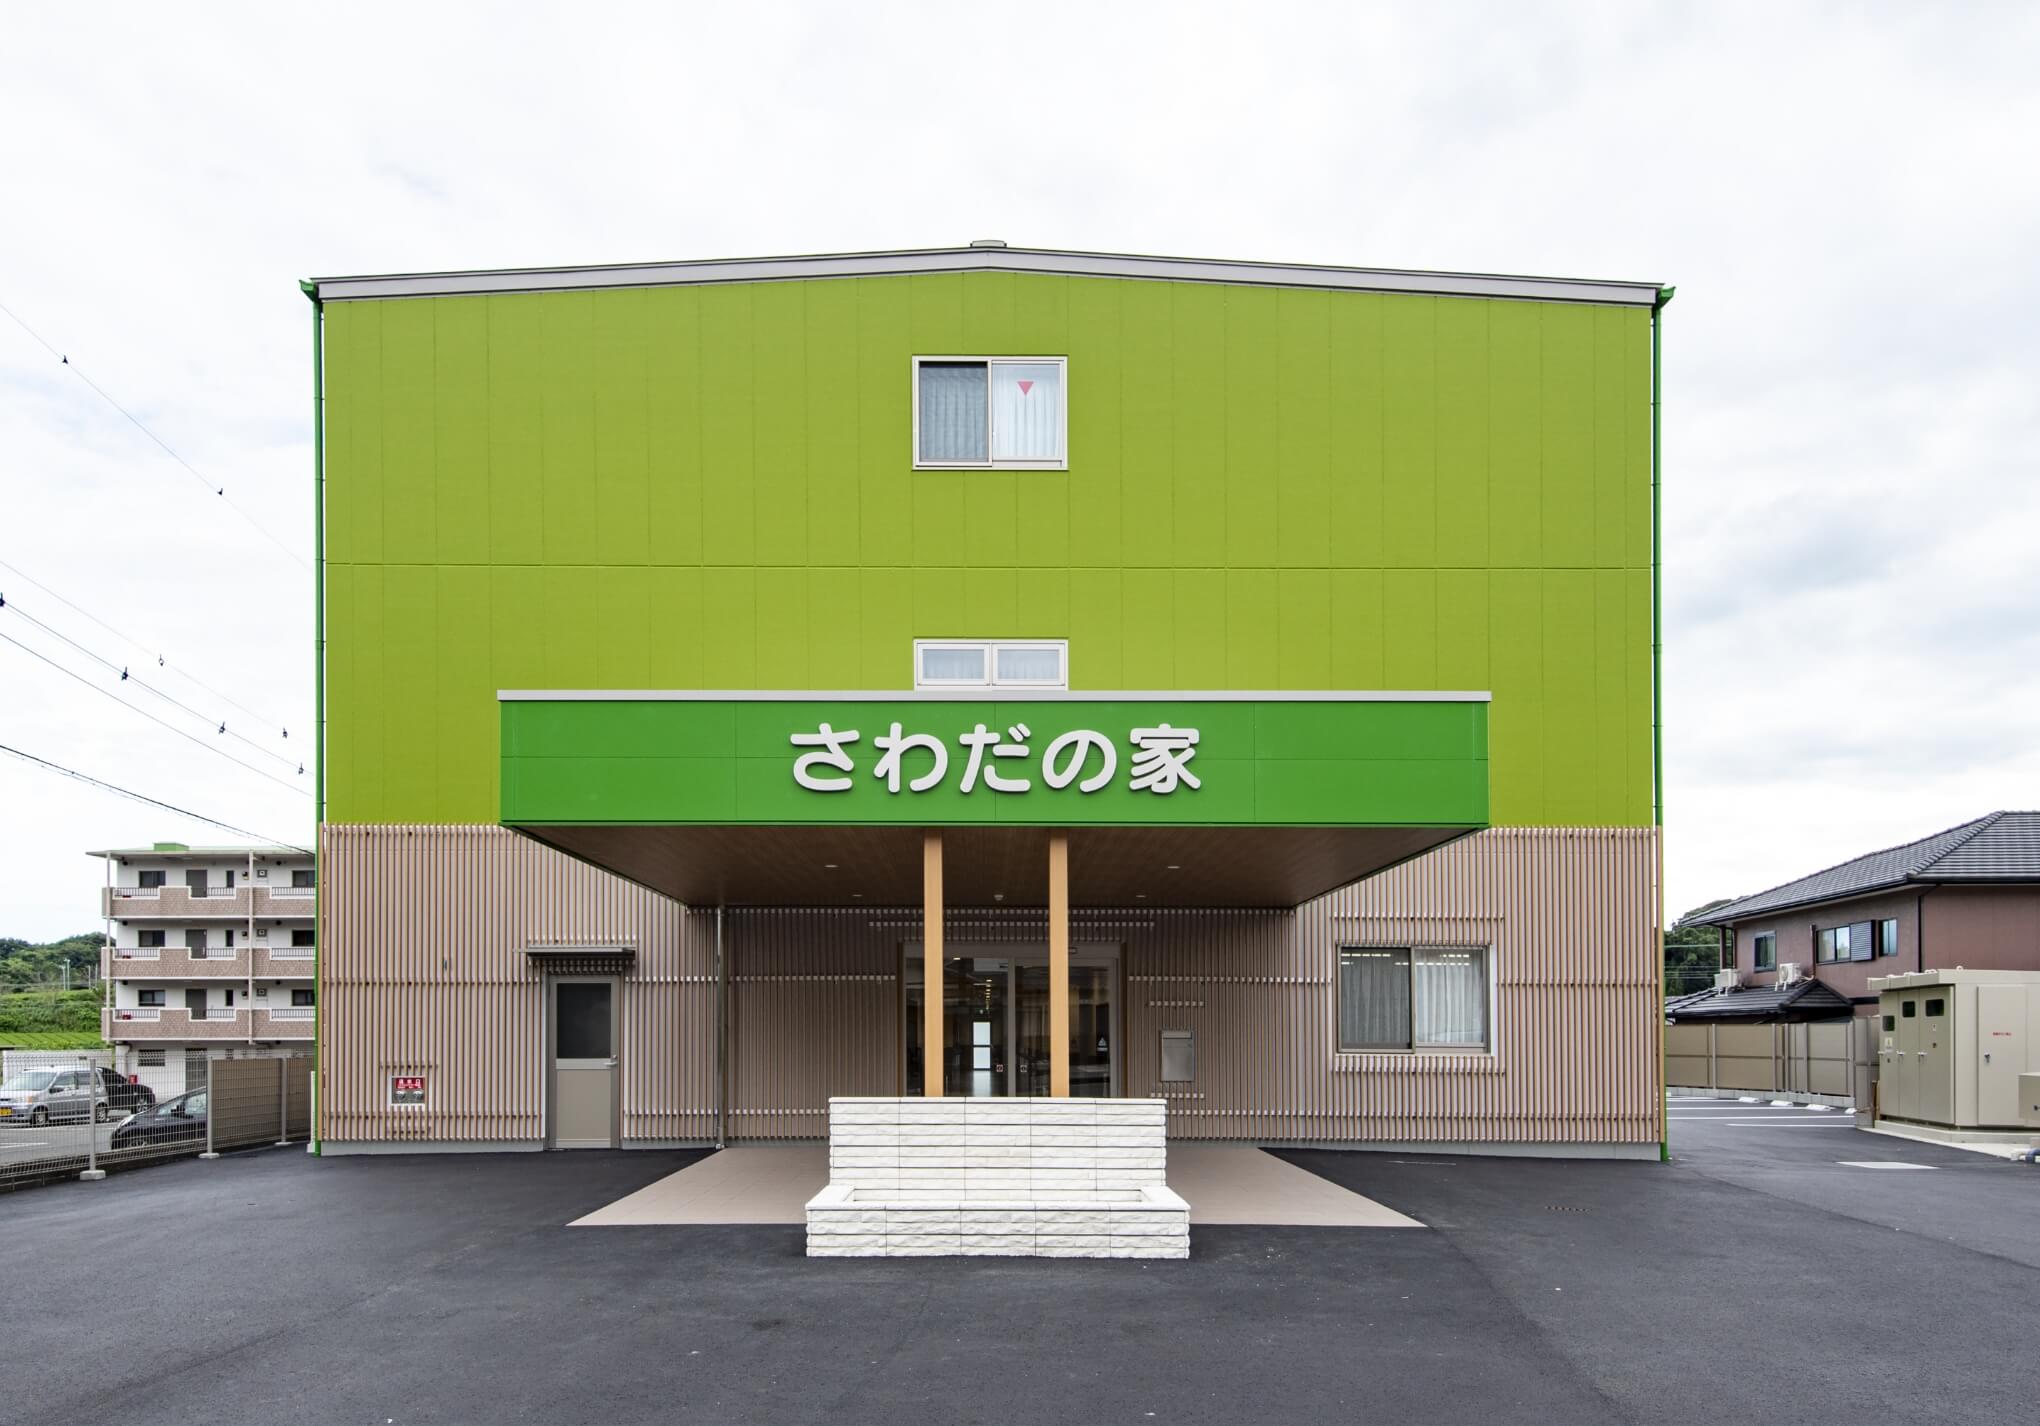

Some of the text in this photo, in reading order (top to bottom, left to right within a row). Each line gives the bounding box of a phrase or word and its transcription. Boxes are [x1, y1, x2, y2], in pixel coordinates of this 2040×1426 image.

[790, 722, 1201, 794] さわだの家
